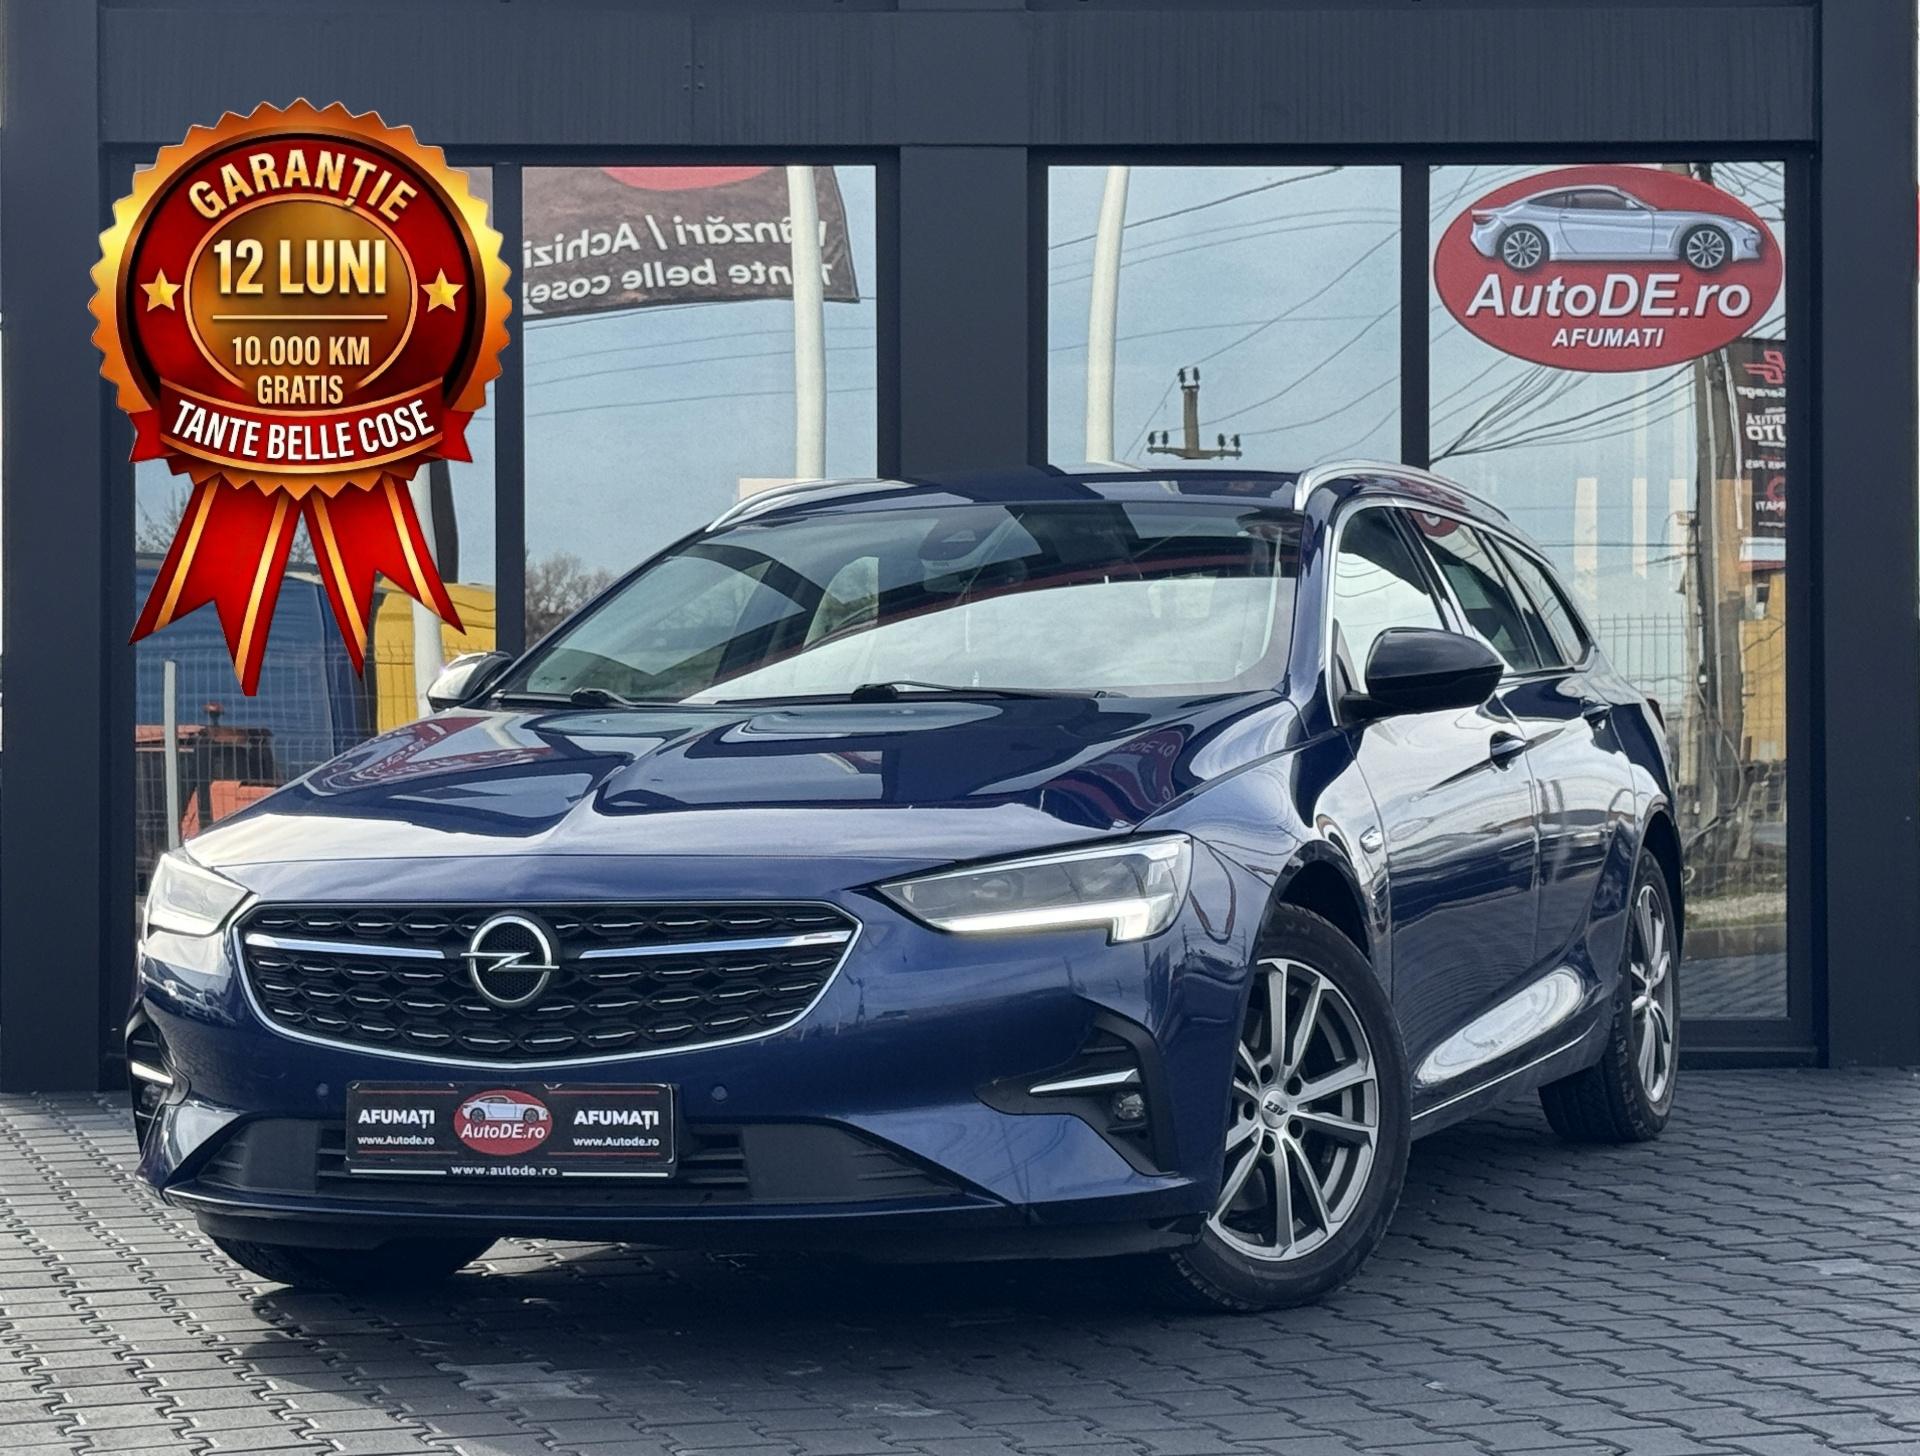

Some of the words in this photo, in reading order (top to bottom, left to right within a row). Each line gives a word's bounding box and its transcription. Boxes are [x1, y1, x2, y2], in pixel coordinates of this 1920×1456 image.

[1466, 273, 1752, 318] AutoDE.ro
[1551, 327, 1664, 348] AFUMATI
[358, 1110, 435, 1129] AFUMAȚI
[574, 1110, 660, 1131] AFUMAȚI
[461, 1123, 546, 1140] AutoDE.ro
[357, 1136, 435, 1146] www.Autode.ro
[573, 1136, 660, 1147] www.Autode.ro
[450, 1164, 558, 1177] www.autode.ro
